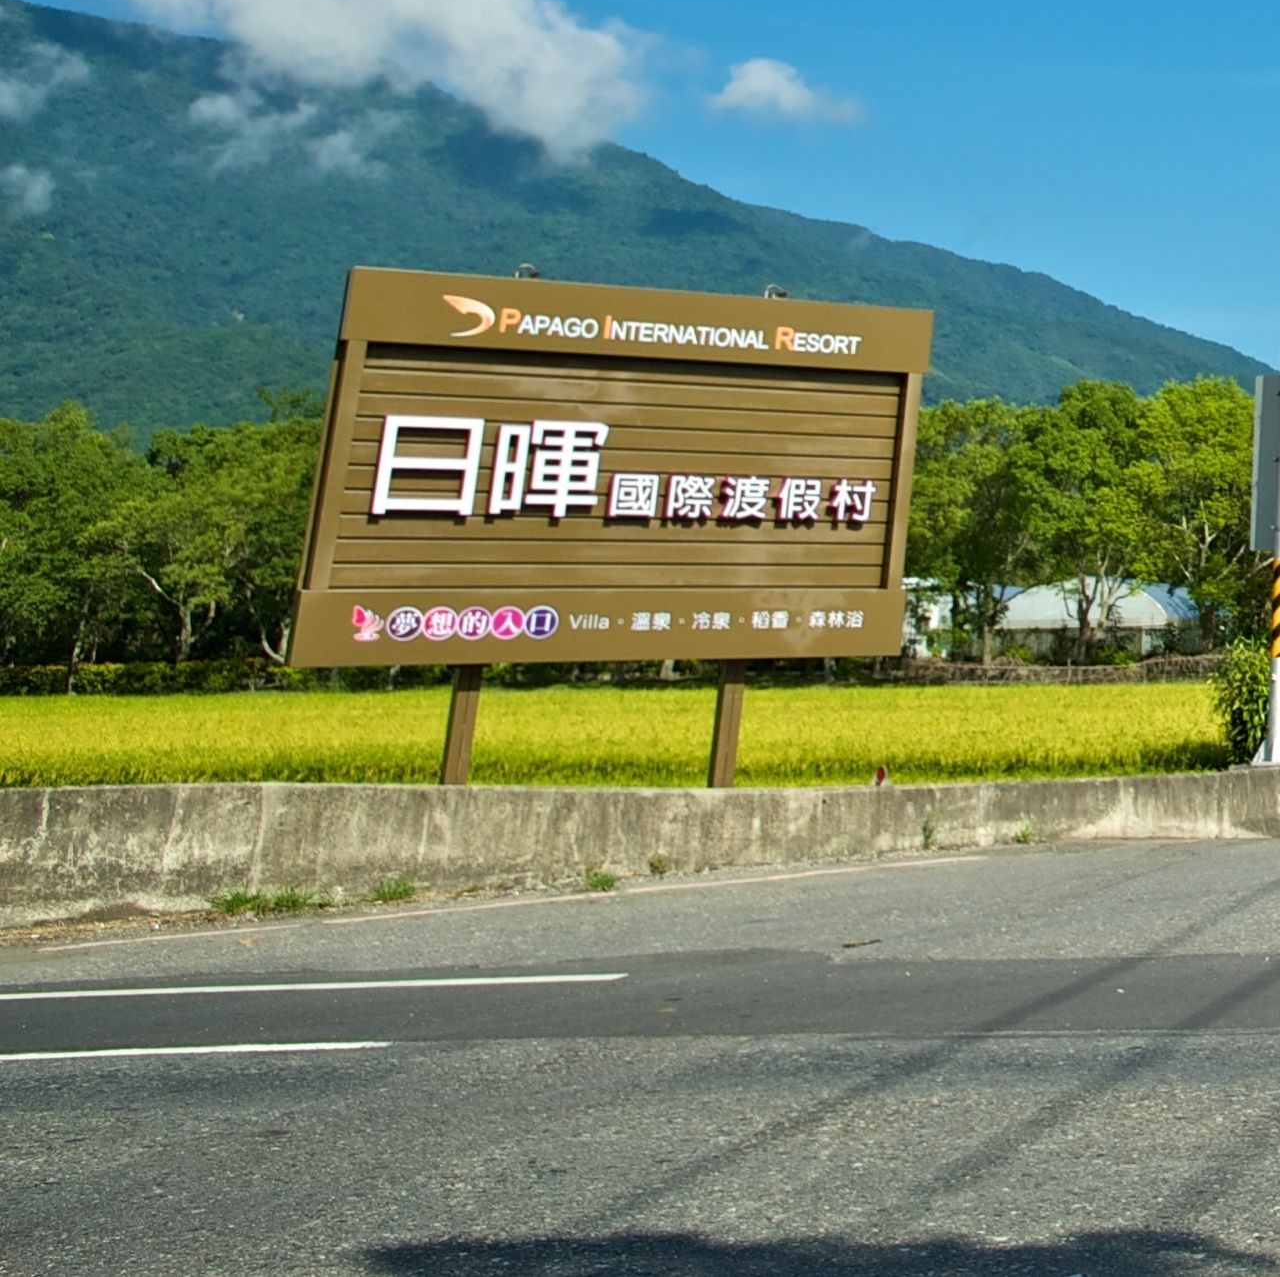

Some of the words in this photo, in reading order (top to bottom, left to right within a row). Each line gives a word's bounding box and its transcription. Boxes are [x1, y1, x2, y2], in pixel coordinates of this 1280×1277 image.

[499, 308, 600, 339] PAPAGO
[604, 315, 770, 351] INTERNATIONAL
[775, 326, 862, 355] RESORT
[371, 414, 610, 518] 日暉
[608, 473, 877, 522] 國際渡假村
[389, 607, 556, 640] 夢想的入口
[568, 613, 611, 631] Villa
